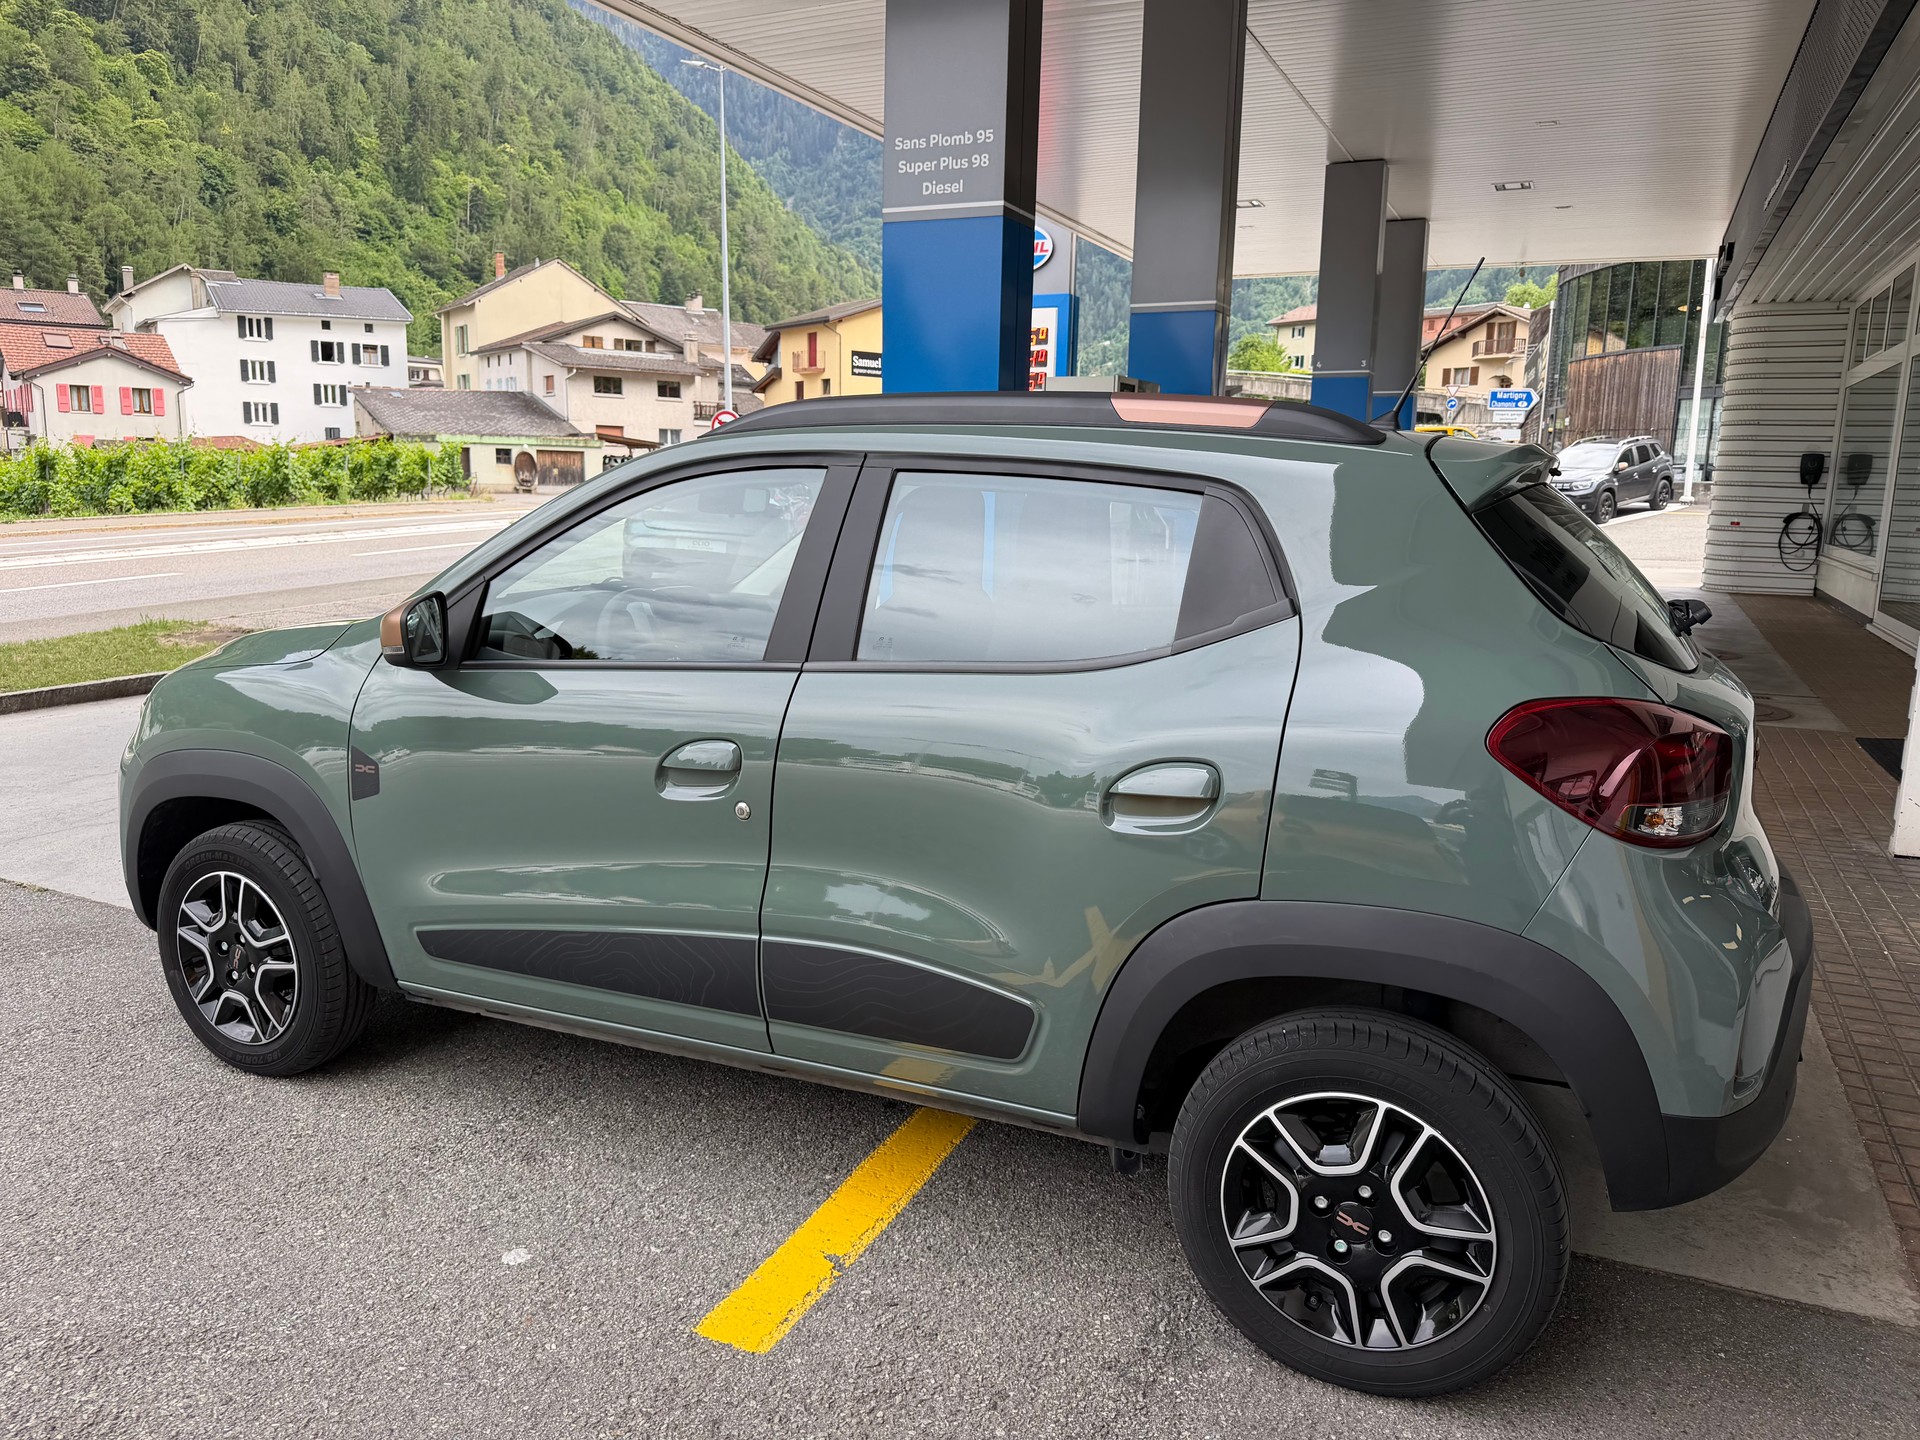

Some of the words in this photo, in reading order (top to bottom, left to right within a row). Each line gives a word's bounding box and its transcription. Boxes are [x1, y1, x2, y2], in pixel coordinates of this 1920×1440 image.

[895, 137, 926, 150] Sans
[929, 131, 973, 148] Plomb
[976, 129, 994, 144] 95
[898, 159, 937, 176] Super
[940, 156, 969, 170] Plus
[971, 153, 989, 168] 98
[922, 179, 963, 195] Diesel
[852, 355, 882, 368] Samuel
[1496, 391, 1527, 400] Martigny
